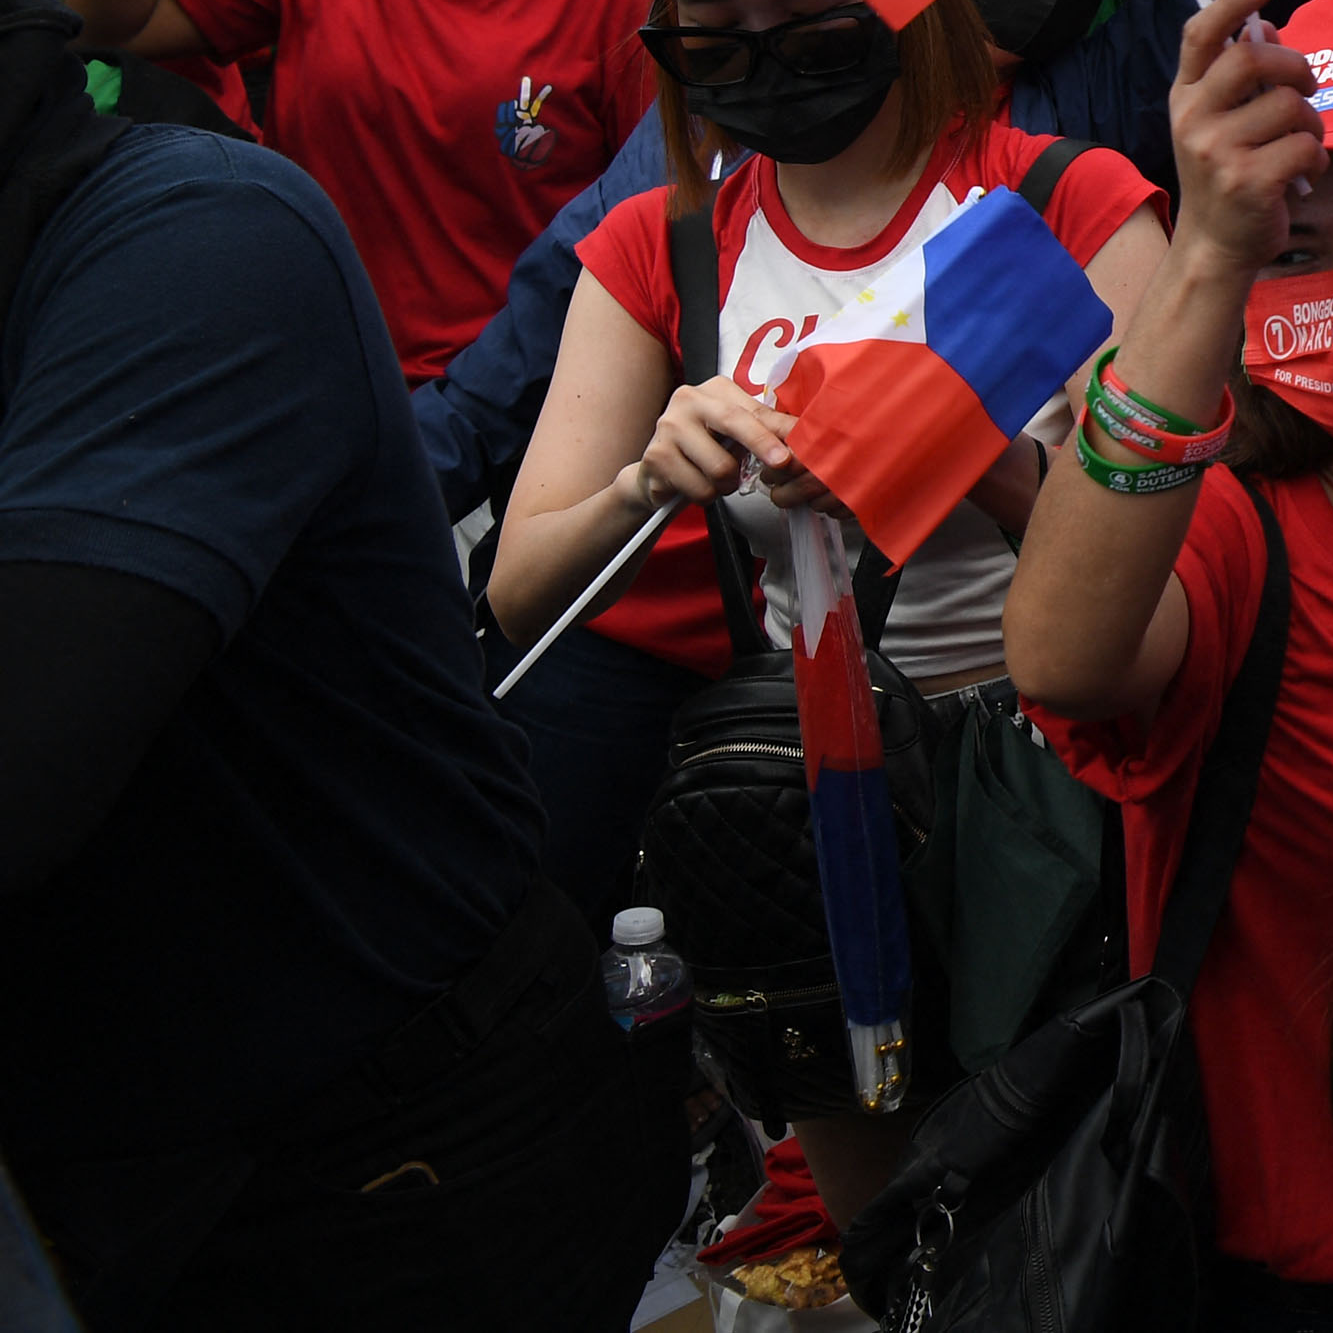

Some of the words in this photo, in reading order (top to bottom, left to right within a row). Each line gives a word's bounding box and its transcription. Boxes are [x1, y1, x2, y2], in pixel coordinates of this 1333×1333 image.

[1274, 368, 1293, 383] FOR
[1136, 467, 1197, 489] DUTERTE
[1137, 465, 1177, 480] SARA
